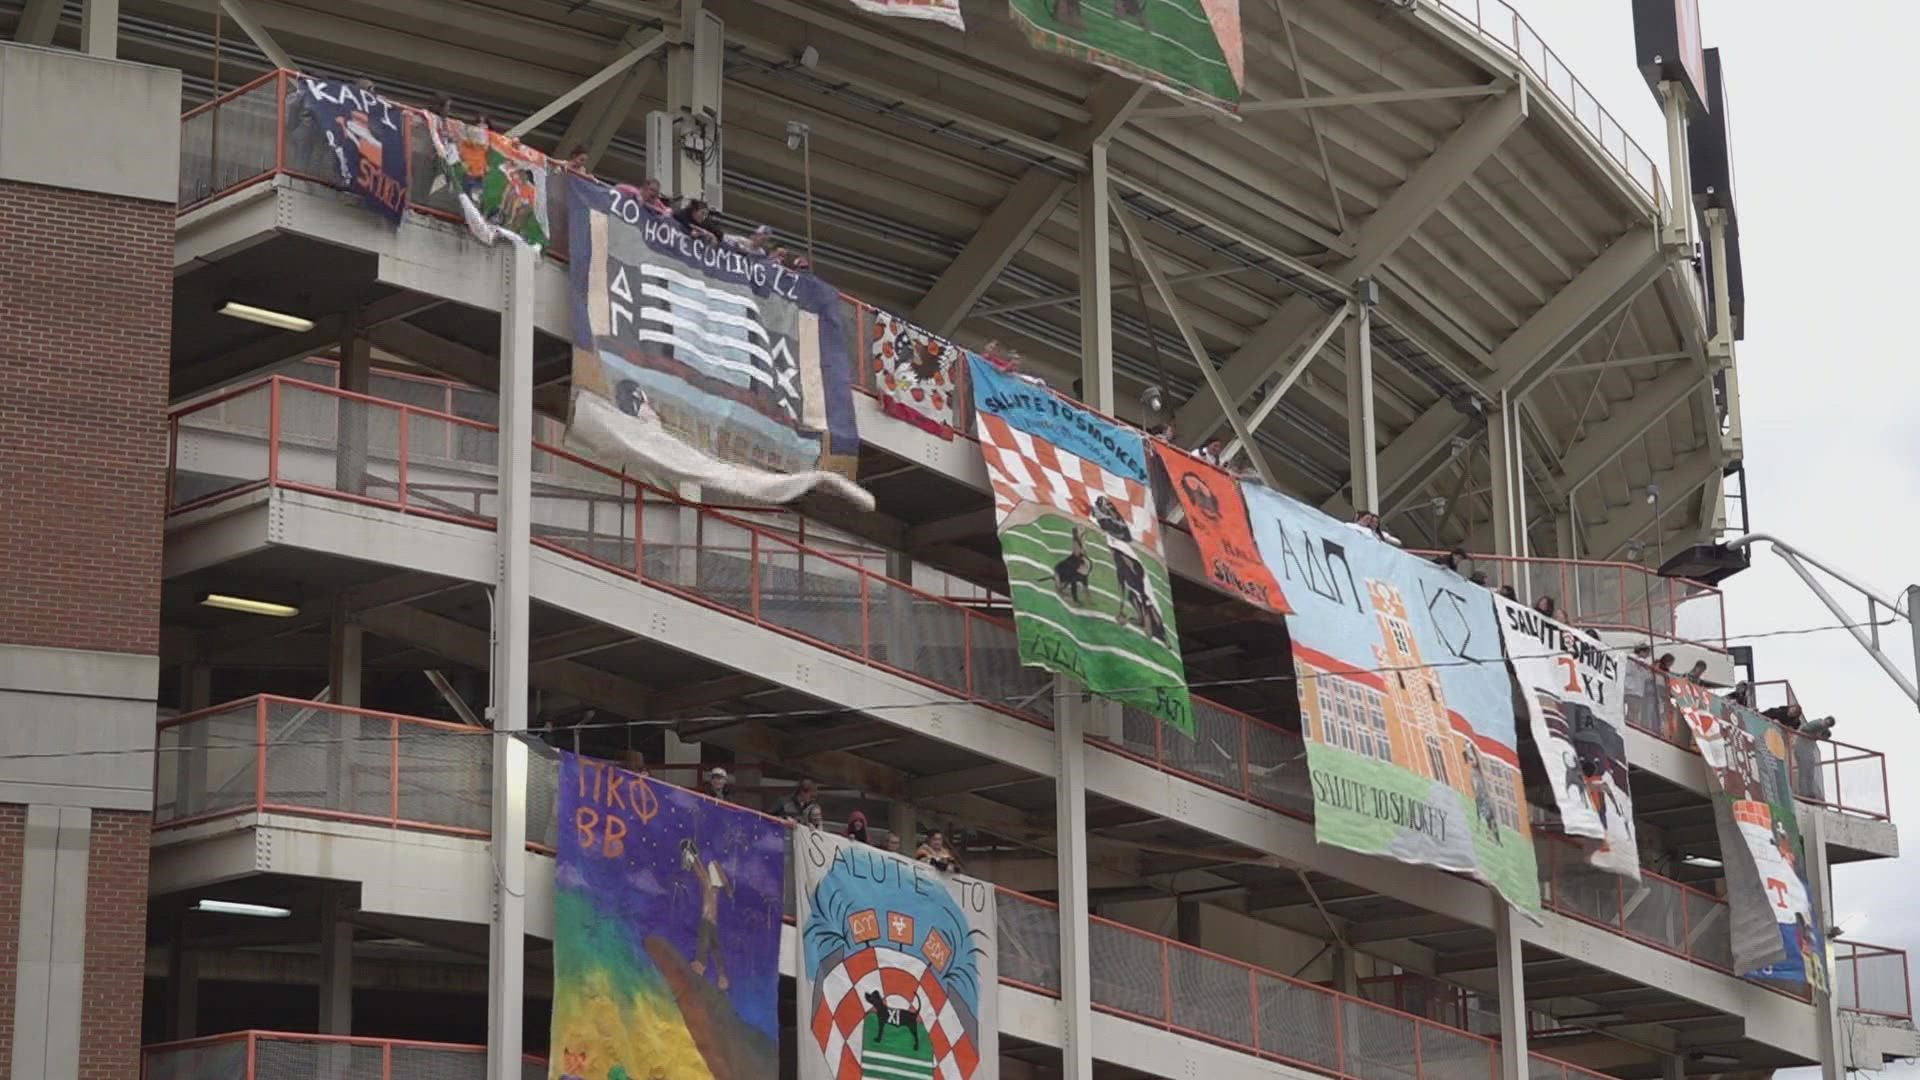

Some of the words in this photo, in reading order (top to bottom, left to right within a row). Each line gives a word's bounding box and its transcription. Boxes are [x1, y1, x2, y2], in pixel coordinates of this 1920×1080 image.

[608, 189, 640, 224] 20
[644, 218, 767, 287] HOMECOMING
[1047, 397, 1074, 422] TO
[1076, 420, 1149, 481] SMOKEY
[1558, 657, 1583, 694] T
[1312, 768, 1371, 818] SALUTE
[1370, 786, 1390, 821] TO
[1389, 791, 1449, 842] SMOKEY
[807, 831, 936, 898] SALUTE
[951, 877, 987, 913] TO
